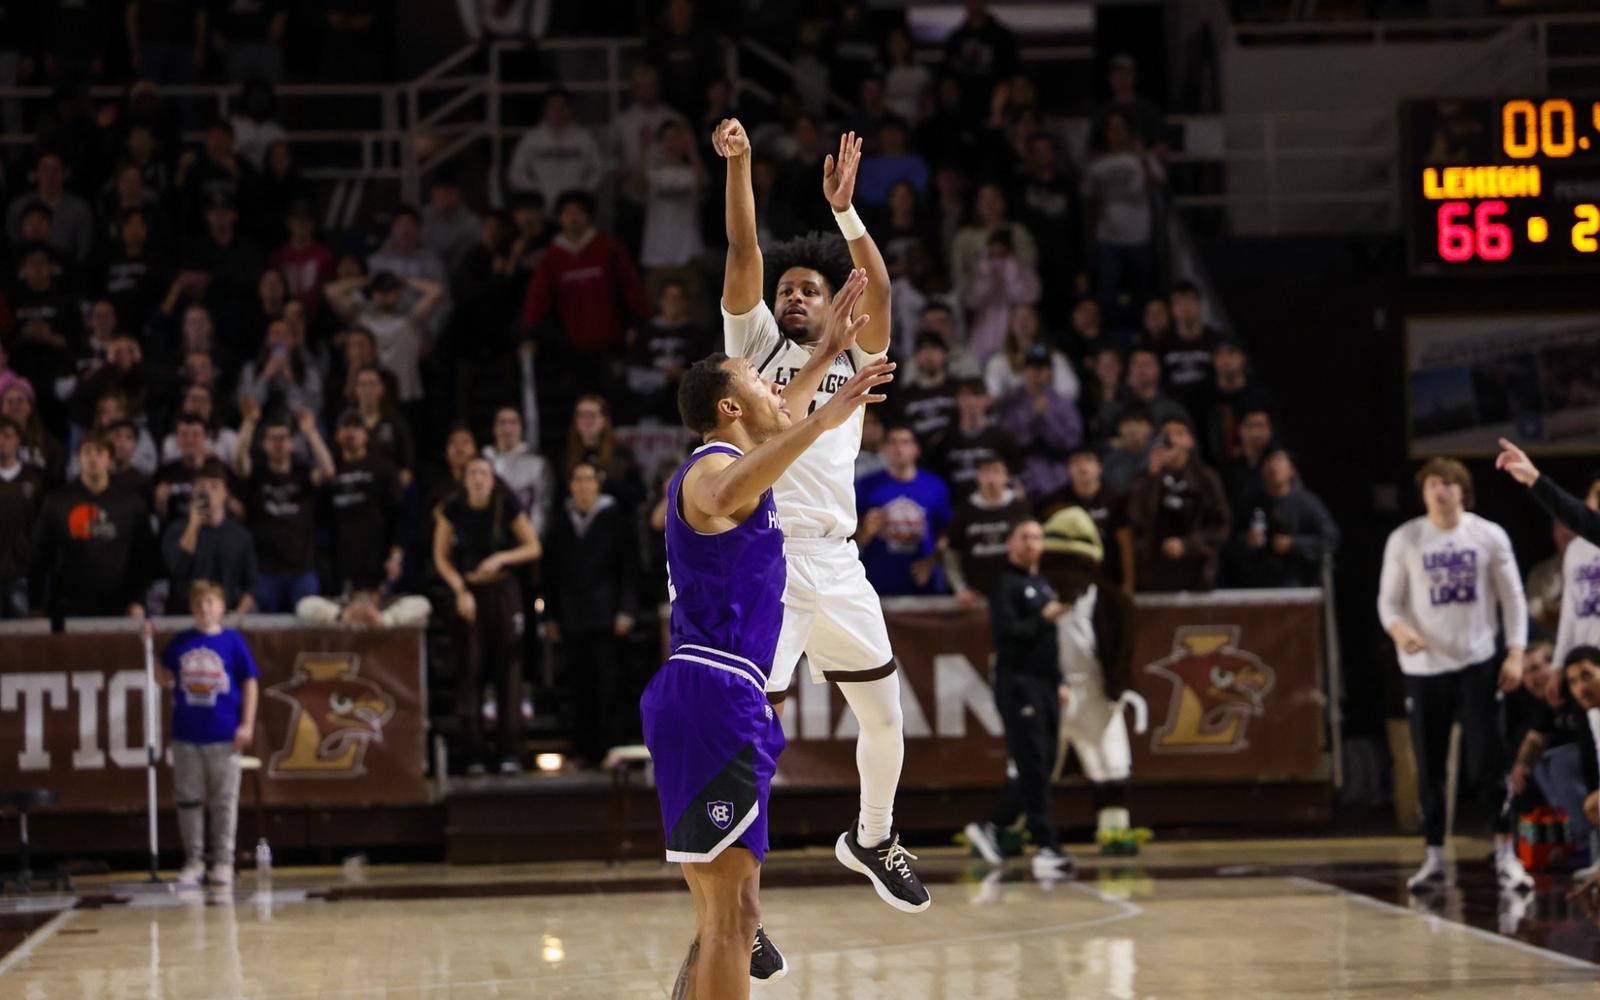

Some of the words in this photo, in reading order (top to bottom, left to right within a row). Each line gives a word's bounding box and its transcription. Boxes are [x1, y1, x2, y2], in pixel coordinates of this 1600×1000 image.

[1422, 165, 1541, 200] LEHIGH
[1437, 201, 1513, 261] 66
[1571, 203, 1600, 252] 2
[774, 366, 849, 394] LEIGH
[0, 669, 174, 772] TIO
[783, 653, 1006, 741] IAN
